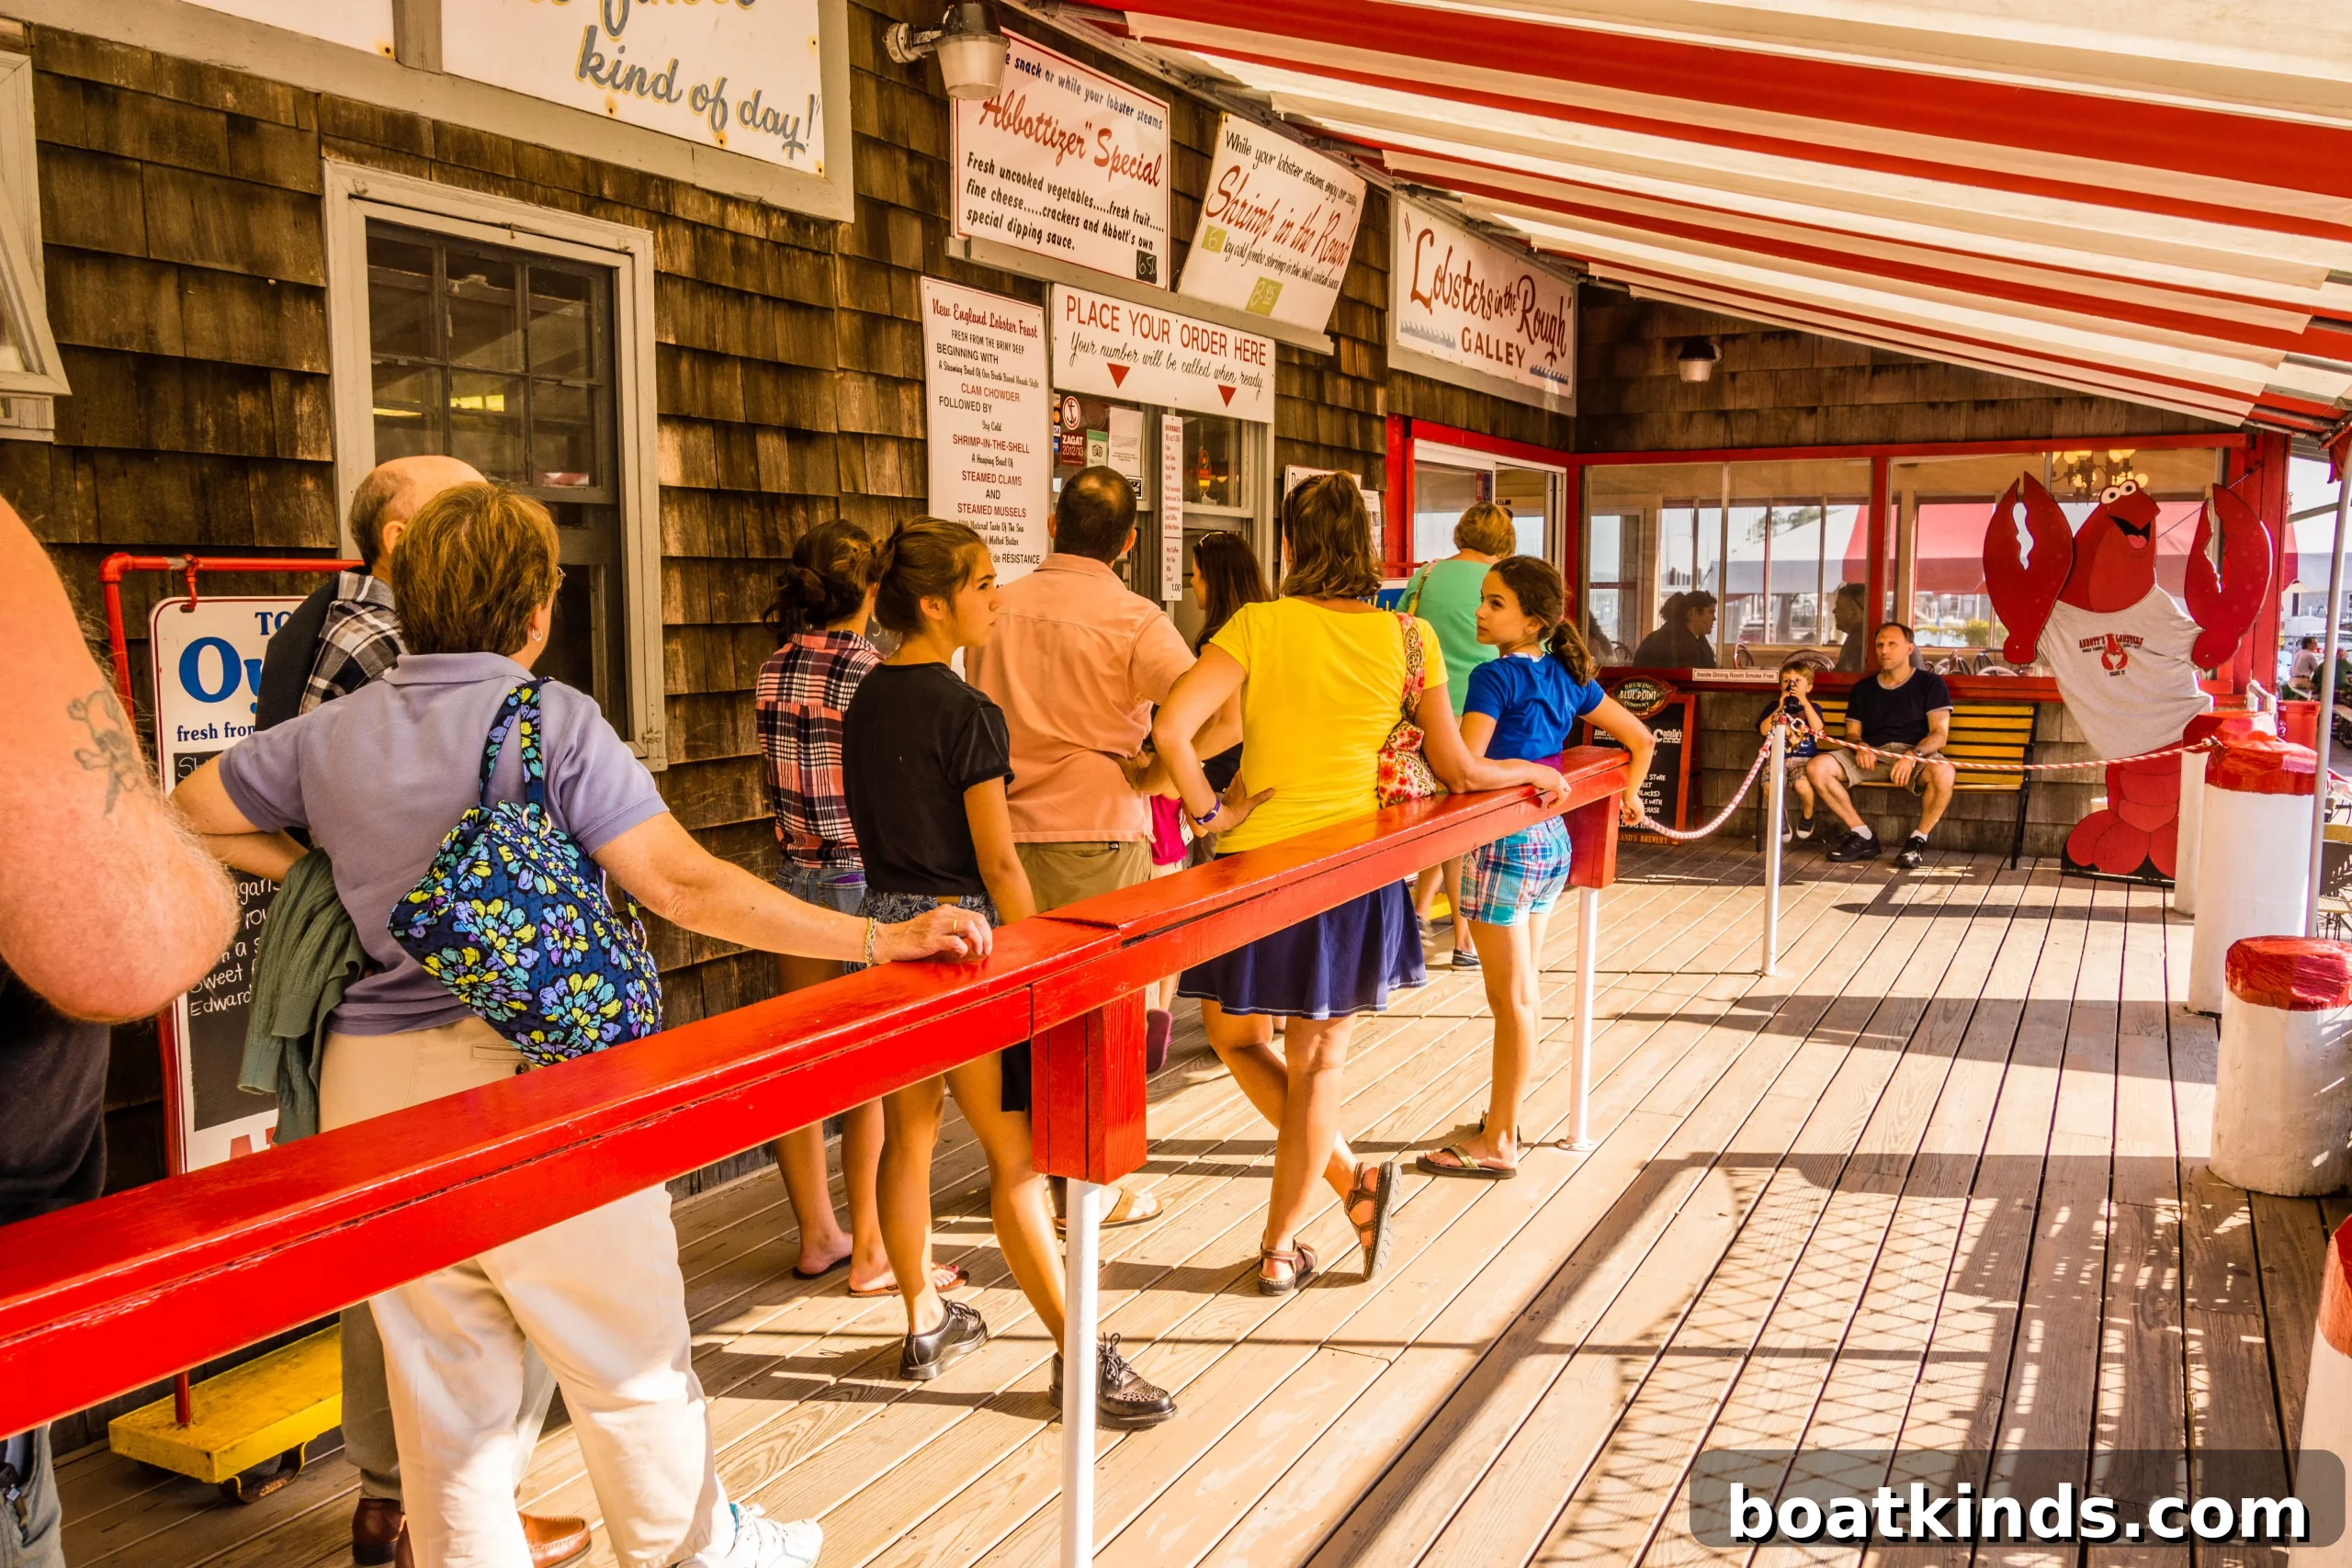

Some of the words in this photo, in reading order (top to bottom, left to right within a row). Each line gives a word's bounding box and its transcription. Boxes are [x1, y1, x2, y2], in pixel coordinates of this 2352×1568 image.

[575, 25, 683, 104] kind
[690, 77, 728, 135] of
[1014, 57, 1042, 79] snack
[1045, 67, 1055, 84] or
[1057, 72, 1081, 96] while
[1084, 87, 1104, 106] your
[1106, 94, 1135, 118] lobster
[1136, 109, 1163, 130] steams
[1093, 128, 1162, 187] Special
[1225, 130, 1252, 156] While
[1252, 148, 1276, 170] your
[1276, 152, 1304, 177] lobster
[967, 152, 995, 175] Fresh
[1000, 166, 1044, 191] uncooked
[967, 178, 986, 198] fine
[1083, 216, 1099, 233] and
[1102, 221, 1135, 245] Abbott's
[1138, 236, 1153, 251] own
[1204, 164, 1280, 246] Shrimp
[1272, 208, 1295, 245] in
[1290, 204, 1321, 254] the
[1311, 209, 1357, 276] Rough
[967, 208, 1003, 231] special
[1007, 218, 1043, 244] dipping
[1046, 231, 1075, 251] sauce.
[1208, 229, 1218, 249] 6
[1224, 236, 1235, 262] Icy
[1233, 242, 1250, 258] cold
[1240, 243, 1266, 267] jumbo
[1264, 253, 1286, 276] shrimp
[1285, 259, 1292, 274] in
[1291, 261, 1301, 276] the
[1327, 277, 1340, 290] sauce
[1250, 280, 1278, 308] 8.95
[1495, 288, 1503, 319] in
[1503, 282, 1517, 317] the
[933, 298, 951, 317] New
[954, 303, 987, 326] England
[989, 312, 1017, 334] Lobster
[1019, 320, 1038, 338] Feast
[1067, 294, 1120, 333] PLACE
[1128, 310, 1170, 344] YOUR
[1180, 323, 1227, 357] ORDER
[1234, 336, 1266, 367] HERE
[951, 329, 968, 342] FRESH
[969, 333, 984, 345] FROM
[985, 337, 995, 348] THE
[996, 340, 1012, 352] BRINY
[1012, 344, 1024, 355] DEEP
[1461, 326, 1525, 368] GALLEY
[936, 343, 978, 361] BEGINNING
[980, 352, 999, 366] WITH
[938, 359, 943, 370] A
[943, 360, 963, 377] Steaming
[964, 365, 975, 376] Bowl
[975, 367, 981, 378] Of
[982, 368, 990, 379] Our
[990, 370, 1002, 381] Broth
[1069, 331, 1098, 367] Your
[1100, 342, 1139, 364] number
[1142, 350, 1162, 368] will
[1166, 354, 1177, 370] be
[1182, 357, 1211, 378] called
[1214, 366, 1238, 384] when
[1239, 371, 1264, 400] ready.
[961, 382, 982, 396] CLAM
[983, 387, 1020, 402] CHOWDER
[939, 395, 981, 412] FOLLOWED
[982, 402, 992, 413] BY
[981, 419, 990, 432] Icy
[990, 421, 1002, 432] Cold
[953, 434, 1030, 454] SHRIMP-IN-THE-SHELL
[1062, 434, 1083, 446] ZAGAT
[971, 453, 976, 463] A
[977, 454, 995, 468] Heaping
[995, 456, 1007, 467] Bowl
[1008, 457, 1013, 468] Of
[1062, 446, 1083, 457] 2012/13
[962, 470, 997, 484] STEAMED
[998, 475, 1023, 486] CLAMS
[985, 489, 1001, 500] AND
[957, 502, 992, 515] STEAMED
[993, 506, 1027, 518] MUSSELS
[989, 522, 1001, 531] Taste
[1016, 523, 1024, 533] Sea
[1005, 536, 1019, 546] Butter
[993, 554, 1001, 563] de
[1171, 583, 1181, 592] 1.00
[1620, 690, 1635, 700] BLUE
[1637, 691, 1657, 701] POINT
[1624, 682, 1654, 691] BREWING
[176, 723, 218, 742] fresh
[1653, 728, 1682, 743] Costello's
[1640, 835, 1668, 843] BREWERY
